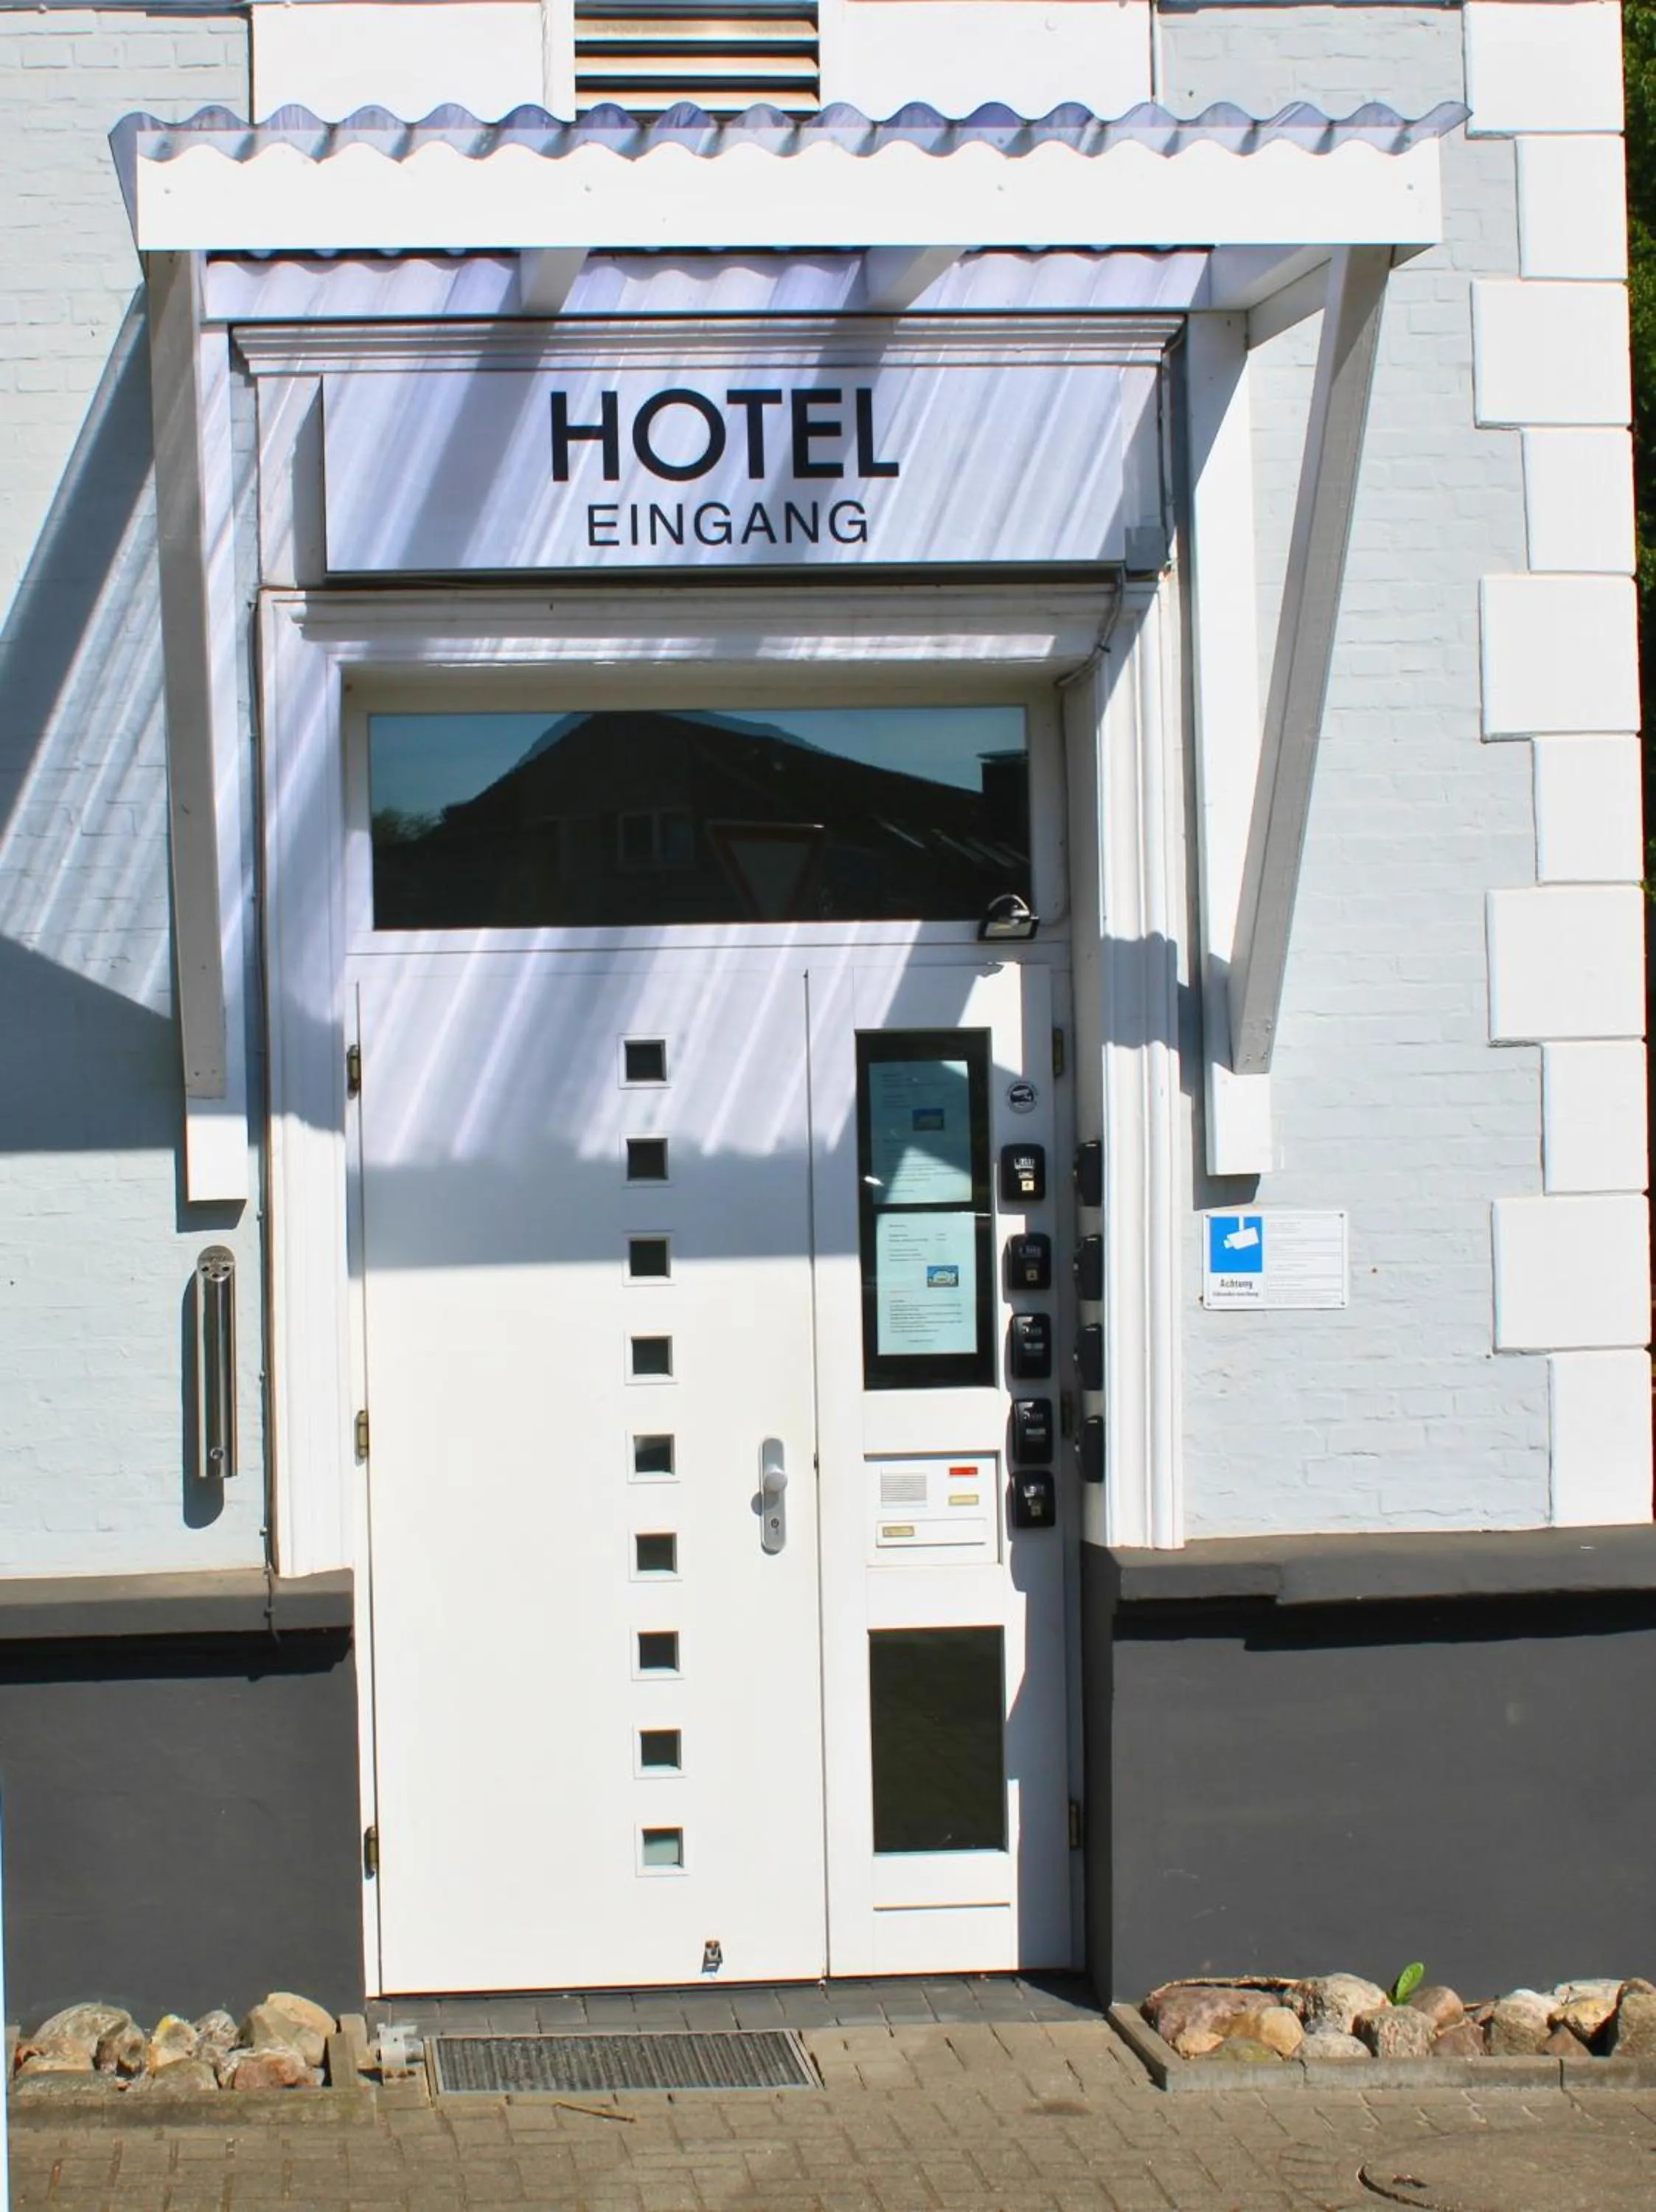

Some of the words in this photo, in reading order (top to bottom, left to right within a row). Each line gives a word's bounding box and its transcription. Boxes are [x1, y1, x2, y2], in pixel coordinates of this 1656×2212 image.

[551, 388, 900, 481] HOTEL
[588, 499, 869, 546] EINGANG
[1220, 1278, 1253, 1290] Achtung
